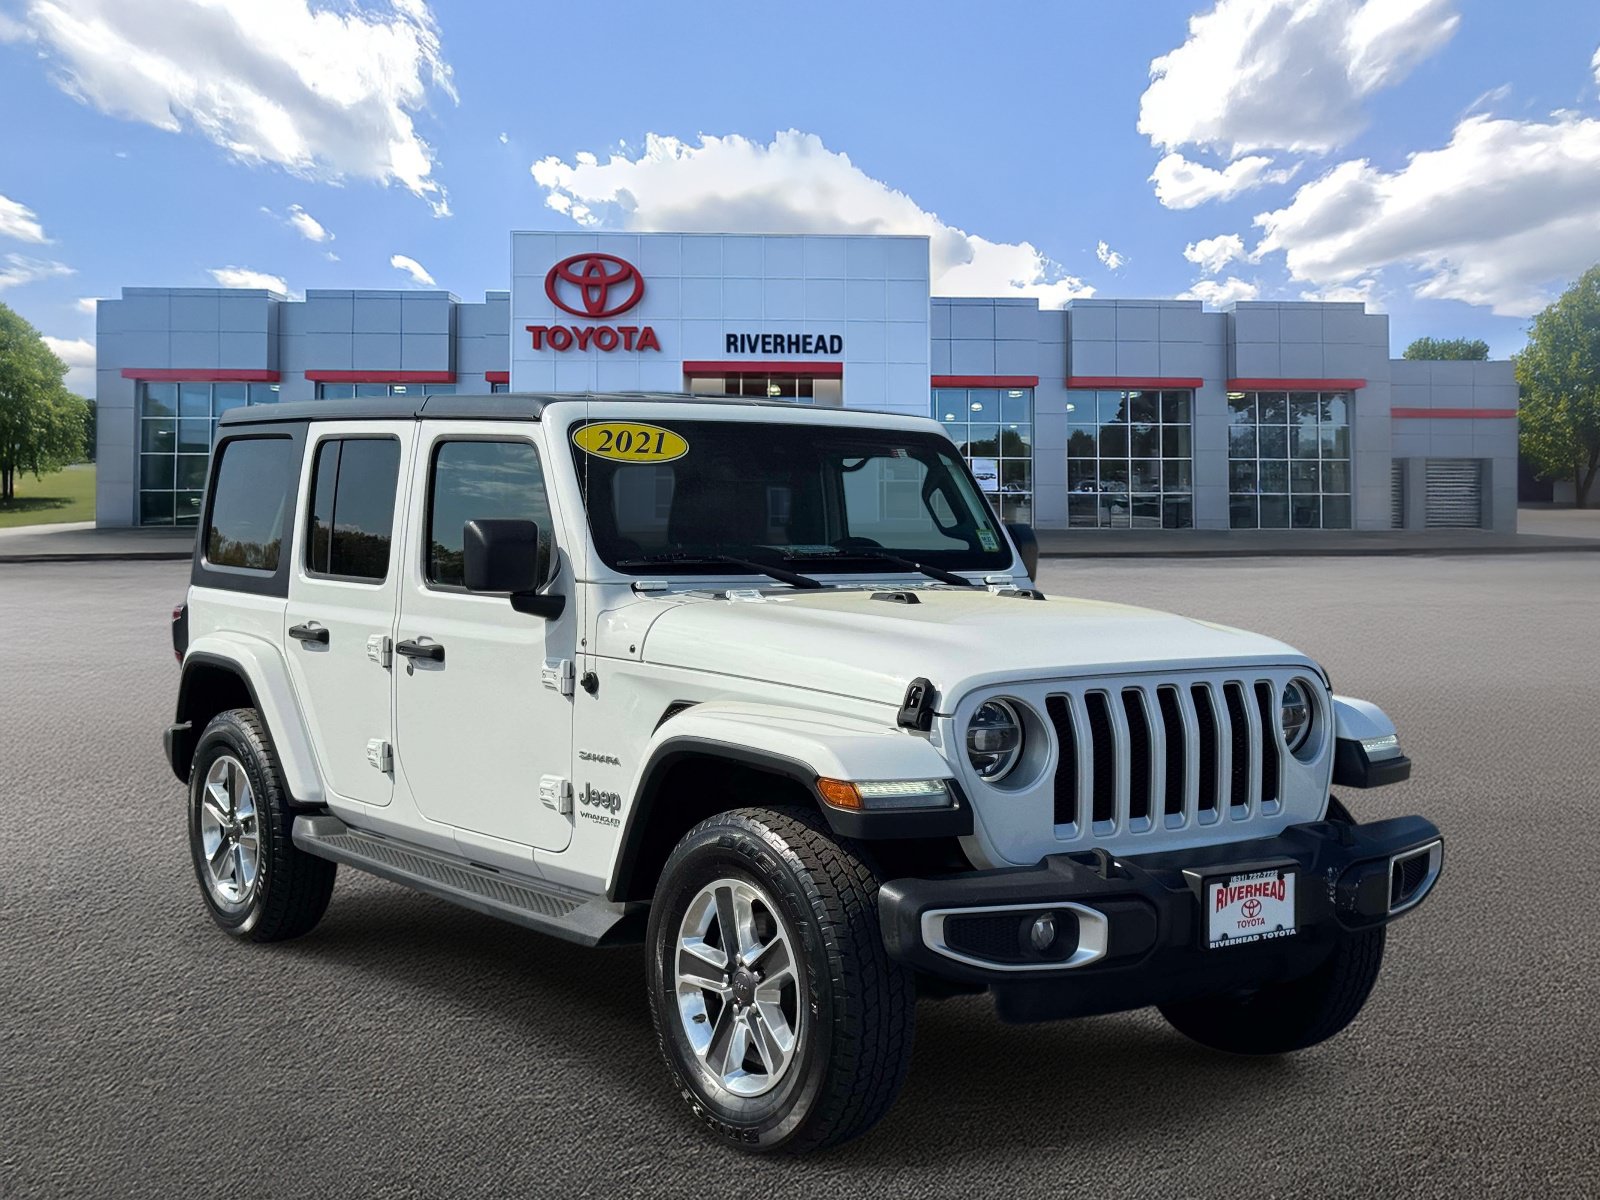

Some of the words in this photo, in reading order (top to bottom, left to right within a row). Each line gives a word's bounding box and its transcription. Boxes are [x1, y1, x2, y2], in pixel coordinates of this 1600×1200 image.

[526, 325, 661, 352] TOYOTA
[726, 333, 843, 355] RIVERHEAD
[596, 430, 667, 455] 2021
[579, 751, 622, 767] SAHARA
[579, 782, 622, 815] Jeep
[580, 811, 621, 826] WRANGLER
[1216, 880, 1286, 914] RIVERHEAD
[1237, 917, 1266, 929] TOYOTA
[1209, 935, 1260, 949] RIVERHEAD
[1262, 928, 1297, 940] TOYOTA
